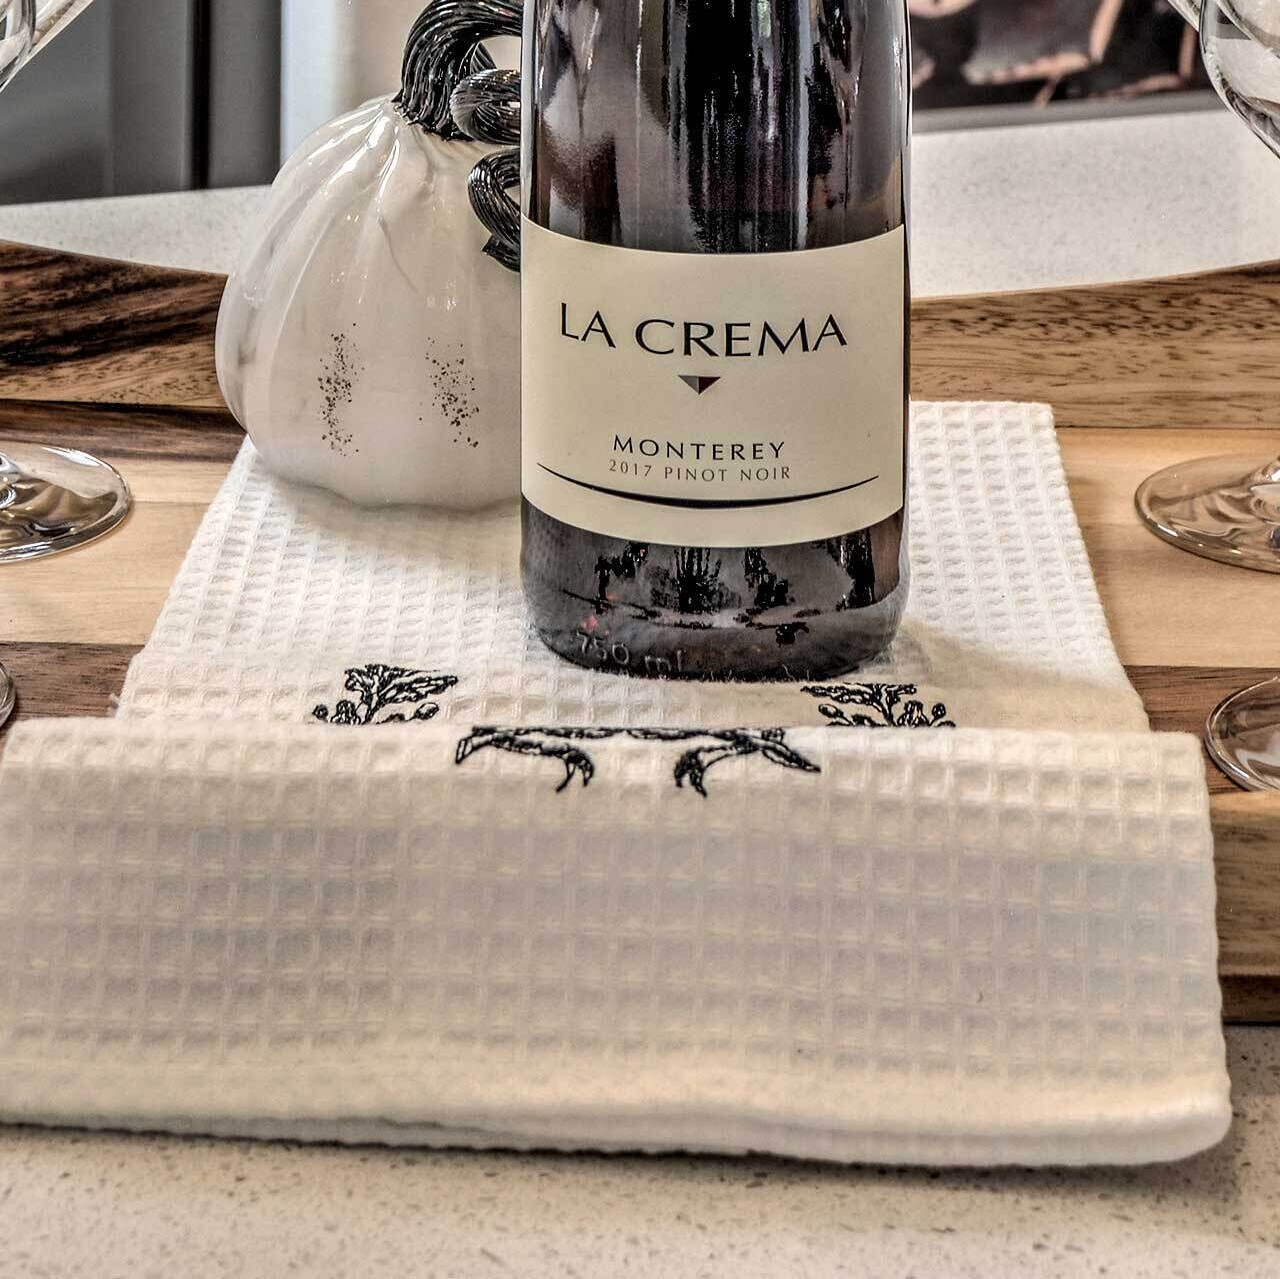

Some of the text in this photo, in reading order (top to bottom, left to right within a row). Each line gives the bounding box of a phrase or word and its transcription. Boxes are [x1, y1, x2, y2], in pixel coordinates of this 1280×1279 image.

[560, 302, 848, 357] LA CREMA
[612, 434, 786, 461] MONTEREY
[608, 459, 792, 482] 2017 PINOT NOIR
[576, 631, 685, 672] 750 ml
